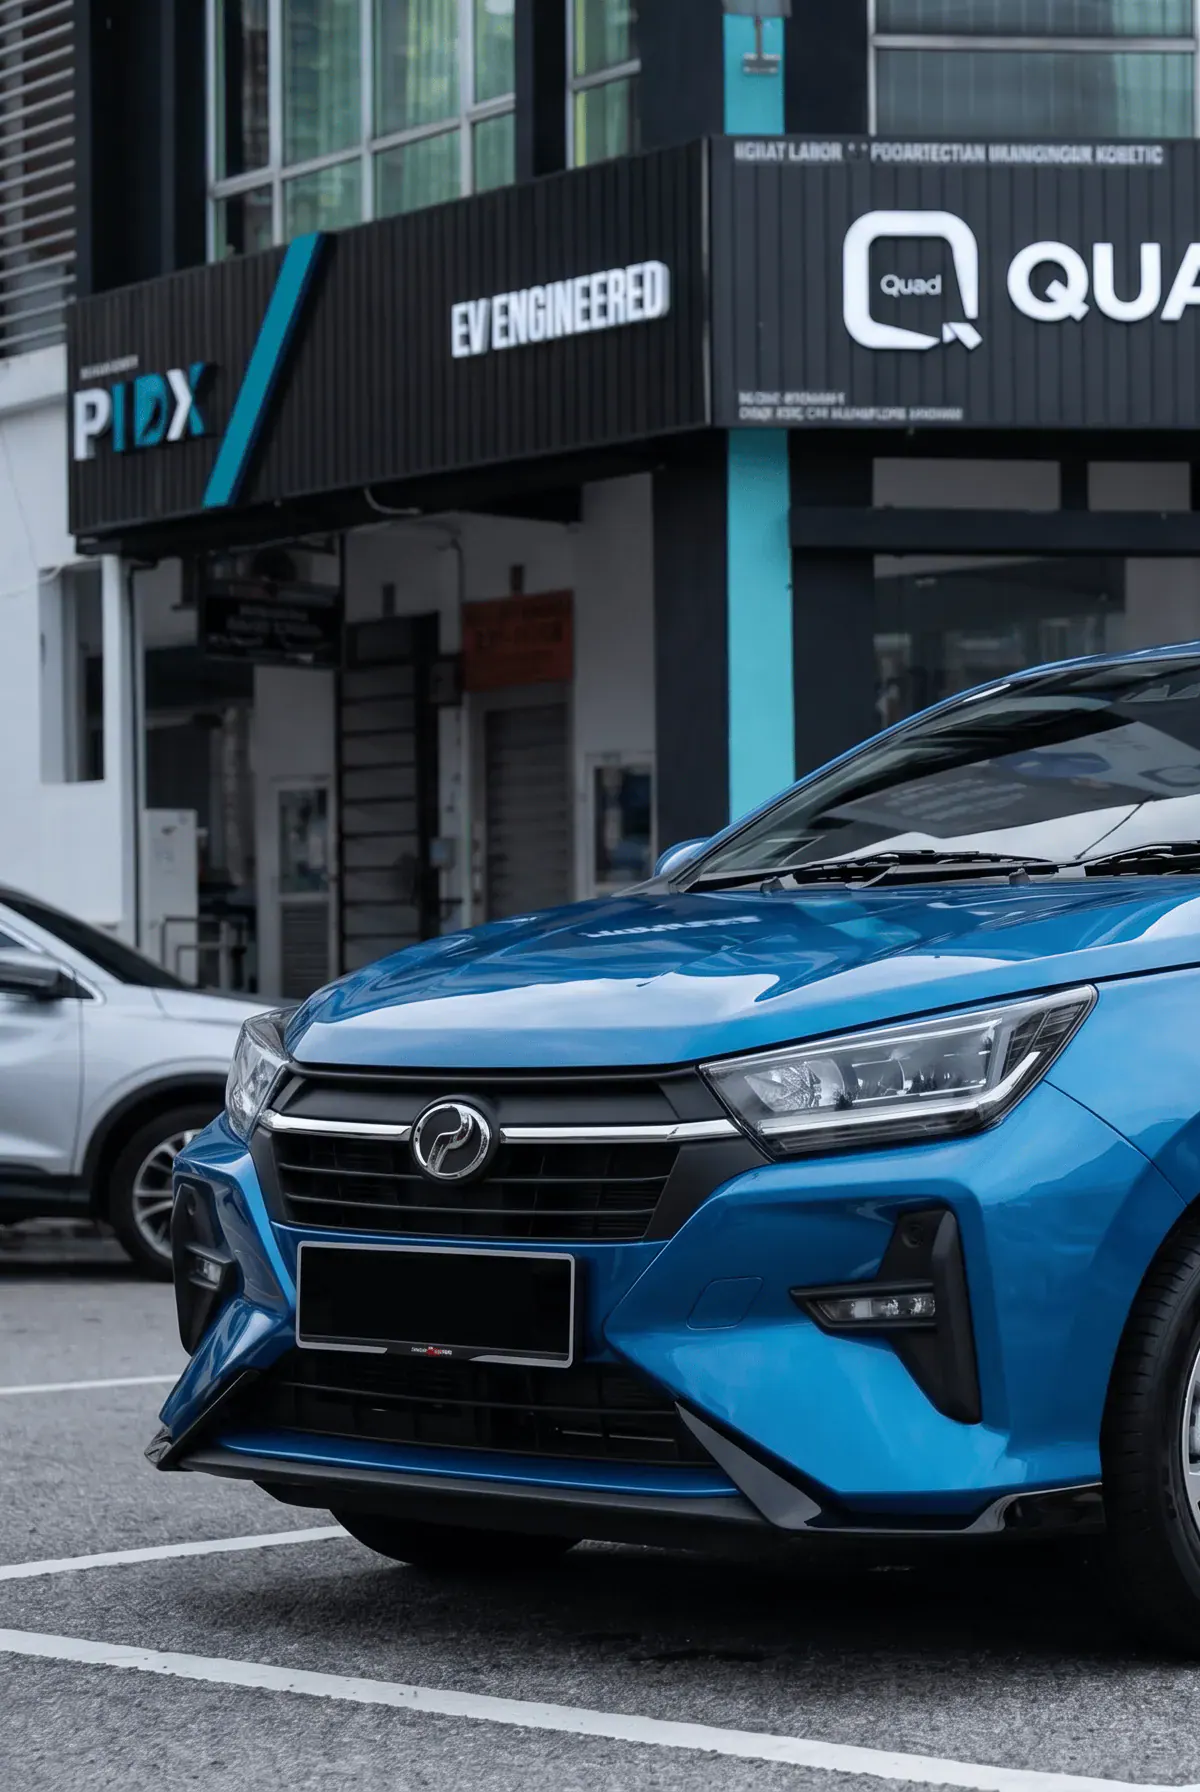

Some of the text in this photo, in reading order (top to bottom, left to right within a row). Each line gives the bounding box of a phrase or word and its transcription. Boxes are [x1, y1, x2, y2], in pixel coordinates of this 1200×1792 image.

[451, 259, 671, 358] EV ENGINEERED
[880, 273, 942, 298] Quad
